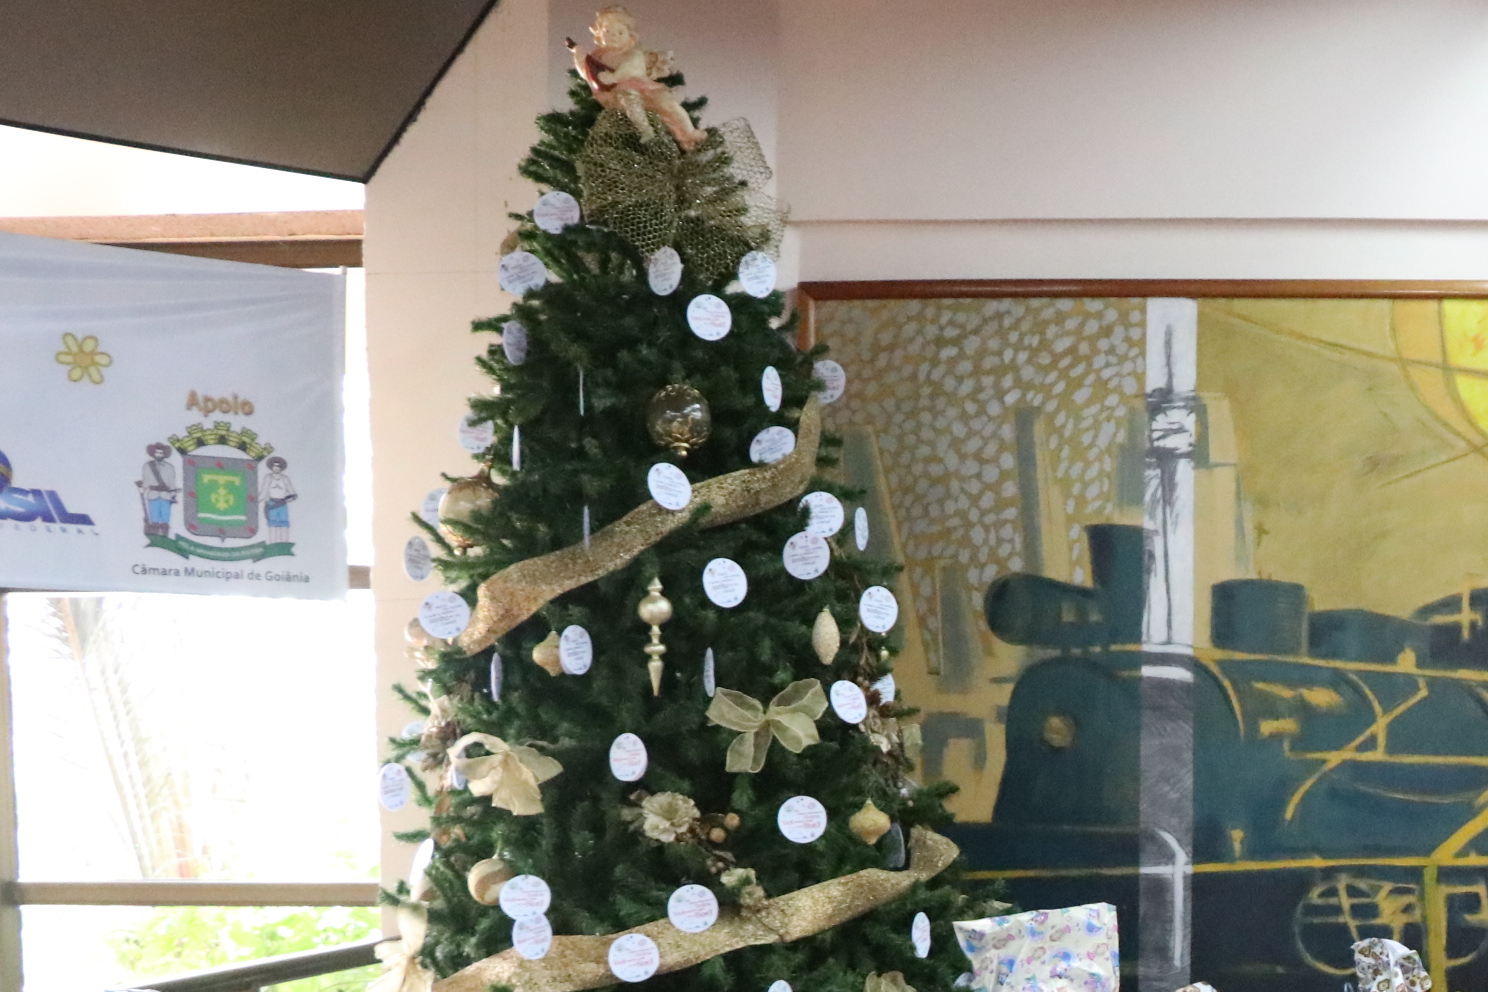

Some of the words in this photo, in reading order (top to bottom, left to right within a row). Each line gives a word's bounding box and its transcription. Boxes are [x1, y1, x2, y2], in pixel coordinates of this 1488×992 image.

[185, 389, 255, 418] Apoio
[131, 563, 181, 578] Câmara
[184, 566, 244, 582] Municipal
[247, 569, 262, 581] de
[264, 570, 310, 584] Goiânia
